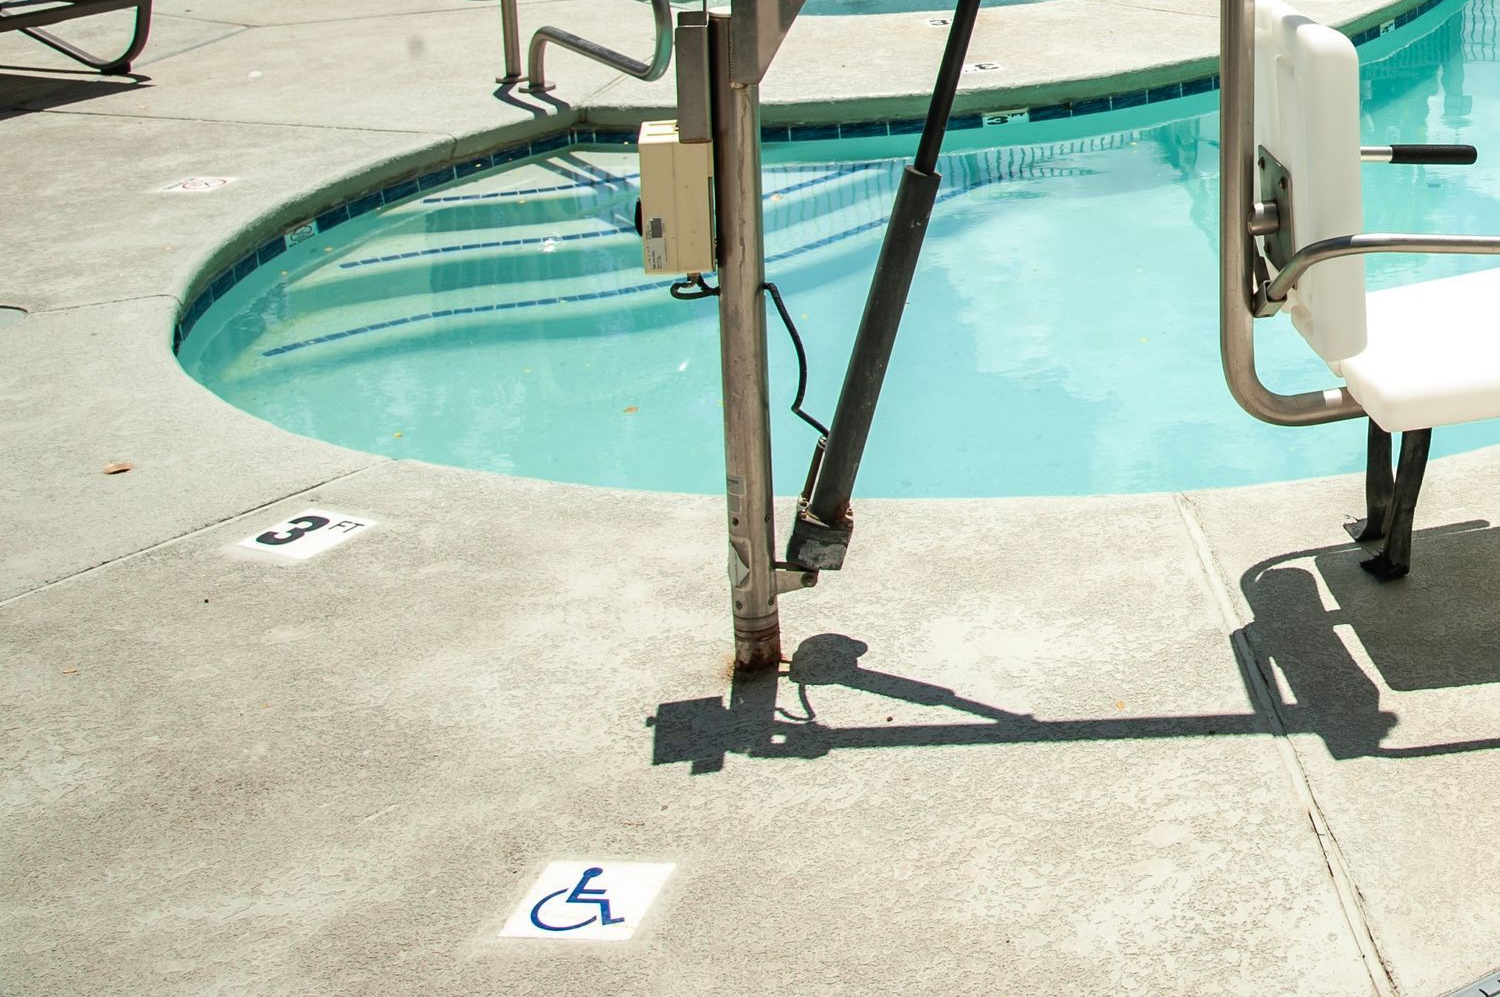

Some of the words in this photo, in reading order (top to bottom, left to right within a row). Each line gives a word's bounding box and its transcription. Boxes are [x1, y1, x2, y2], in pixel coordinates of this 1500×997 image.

[987, 115, 1008, 126] 3
[255, 515, 330, 546] 3
[328, 520, 365, 534] FT
